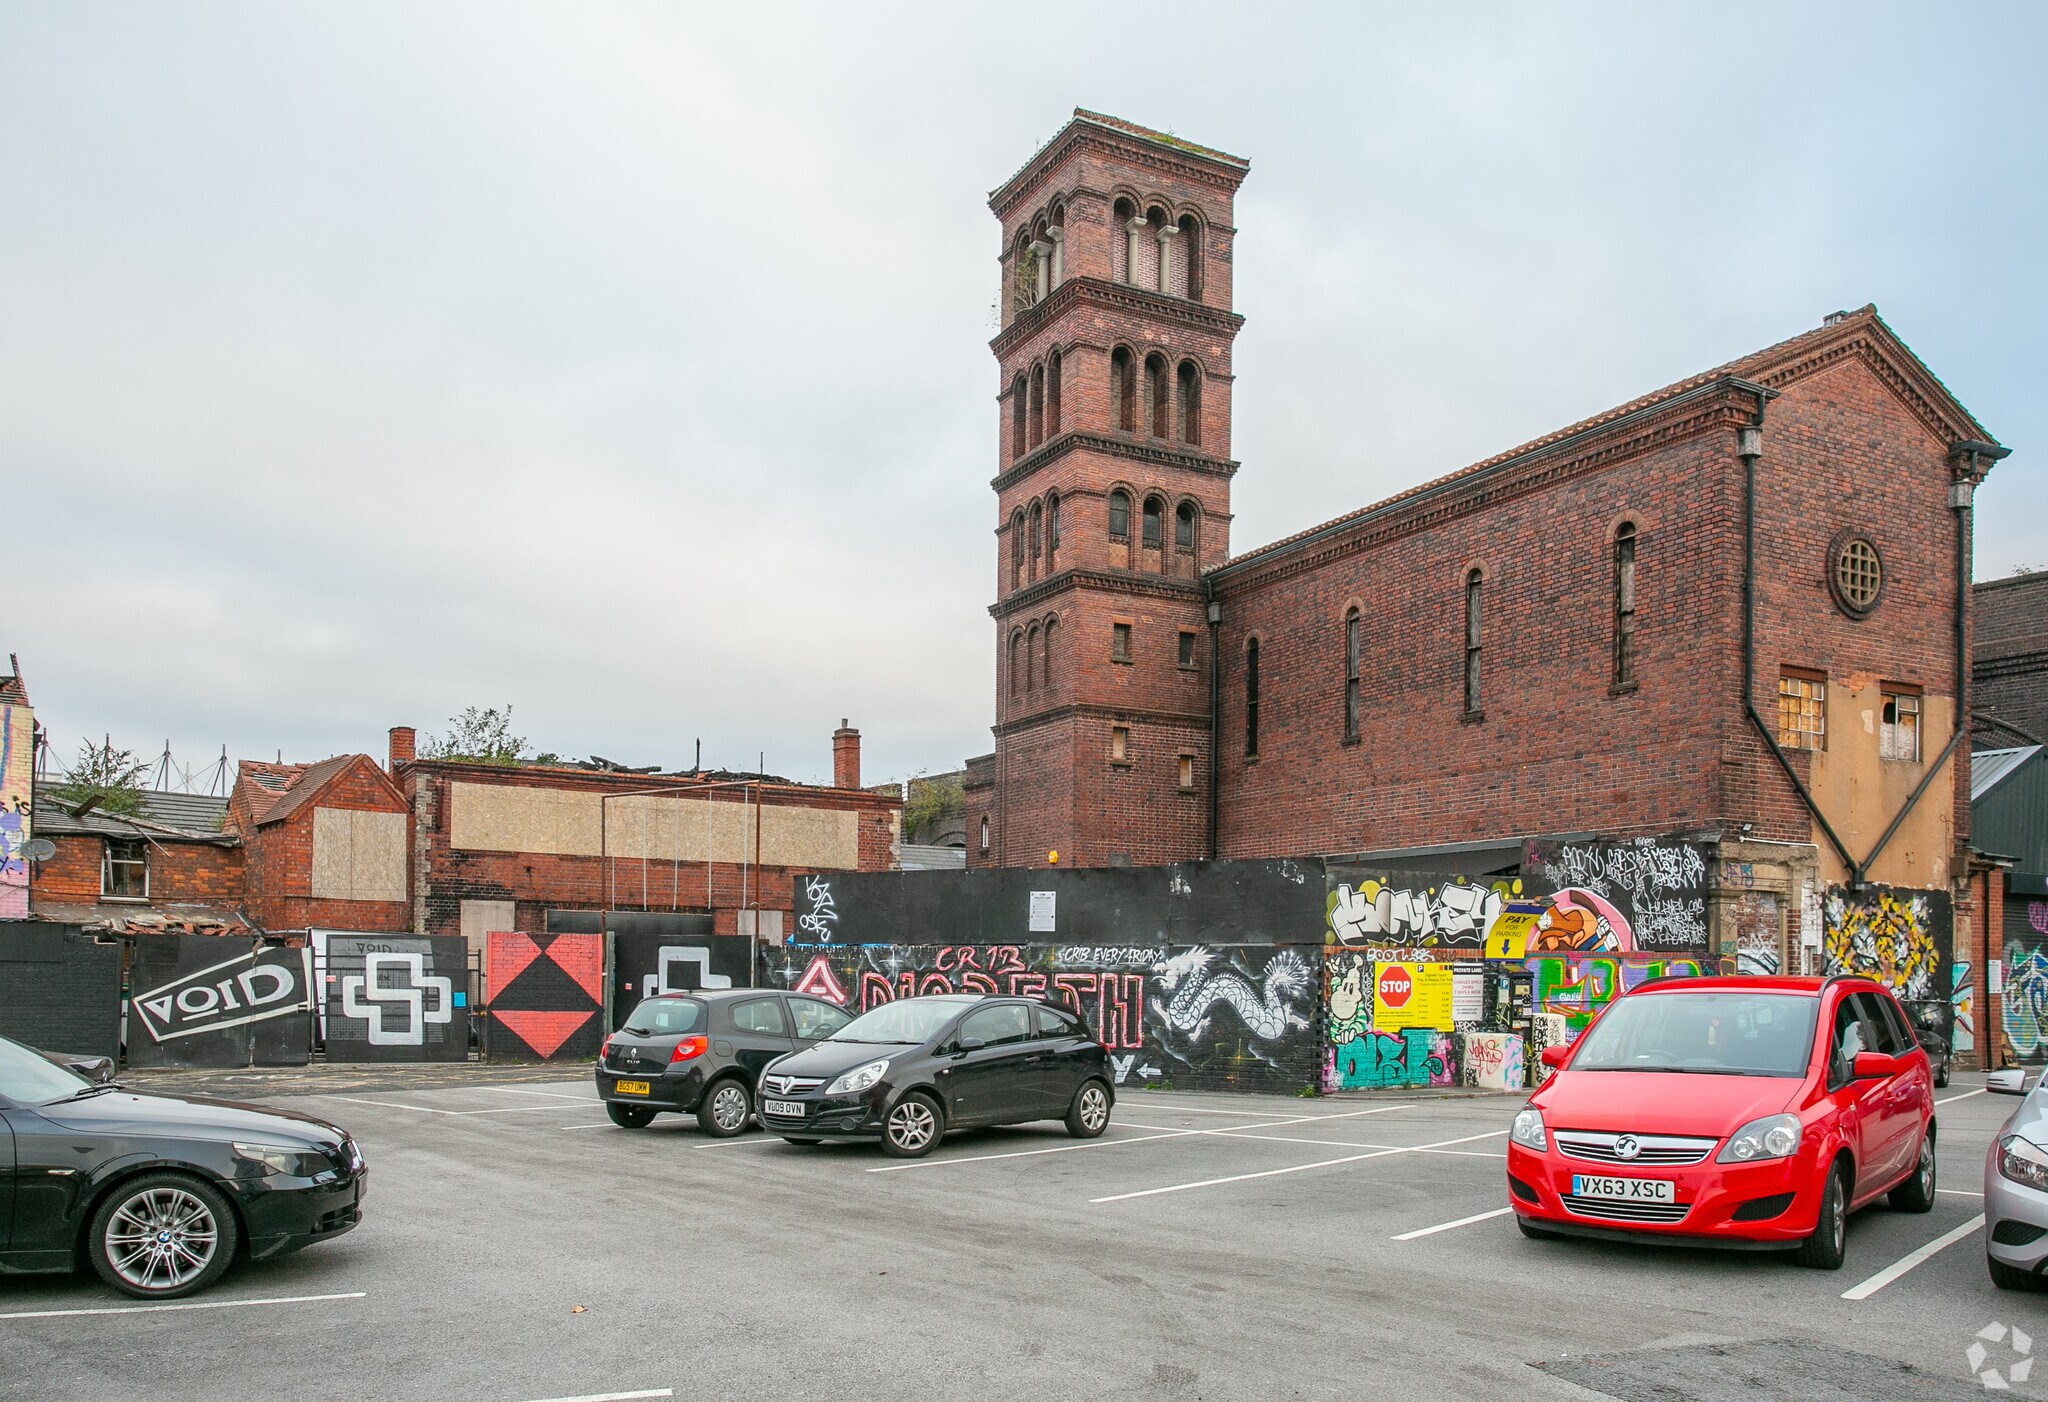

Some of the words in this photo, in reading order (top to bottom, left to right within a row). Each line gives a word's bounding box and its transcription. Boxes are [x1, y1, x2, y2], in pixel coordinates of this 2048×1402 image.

[356, 943, 392, 954] VOID
[1065, 947, 1091, 962] CRIB
[1093, 948, 1127, 967] EVERY
[143, 964, 295, 1024] VOID
[1381, 980, 1410, 993] STOP
[1581, 1177, 1625, 1196] VX63
[1631, 1181, 1666, 1198] XSC
